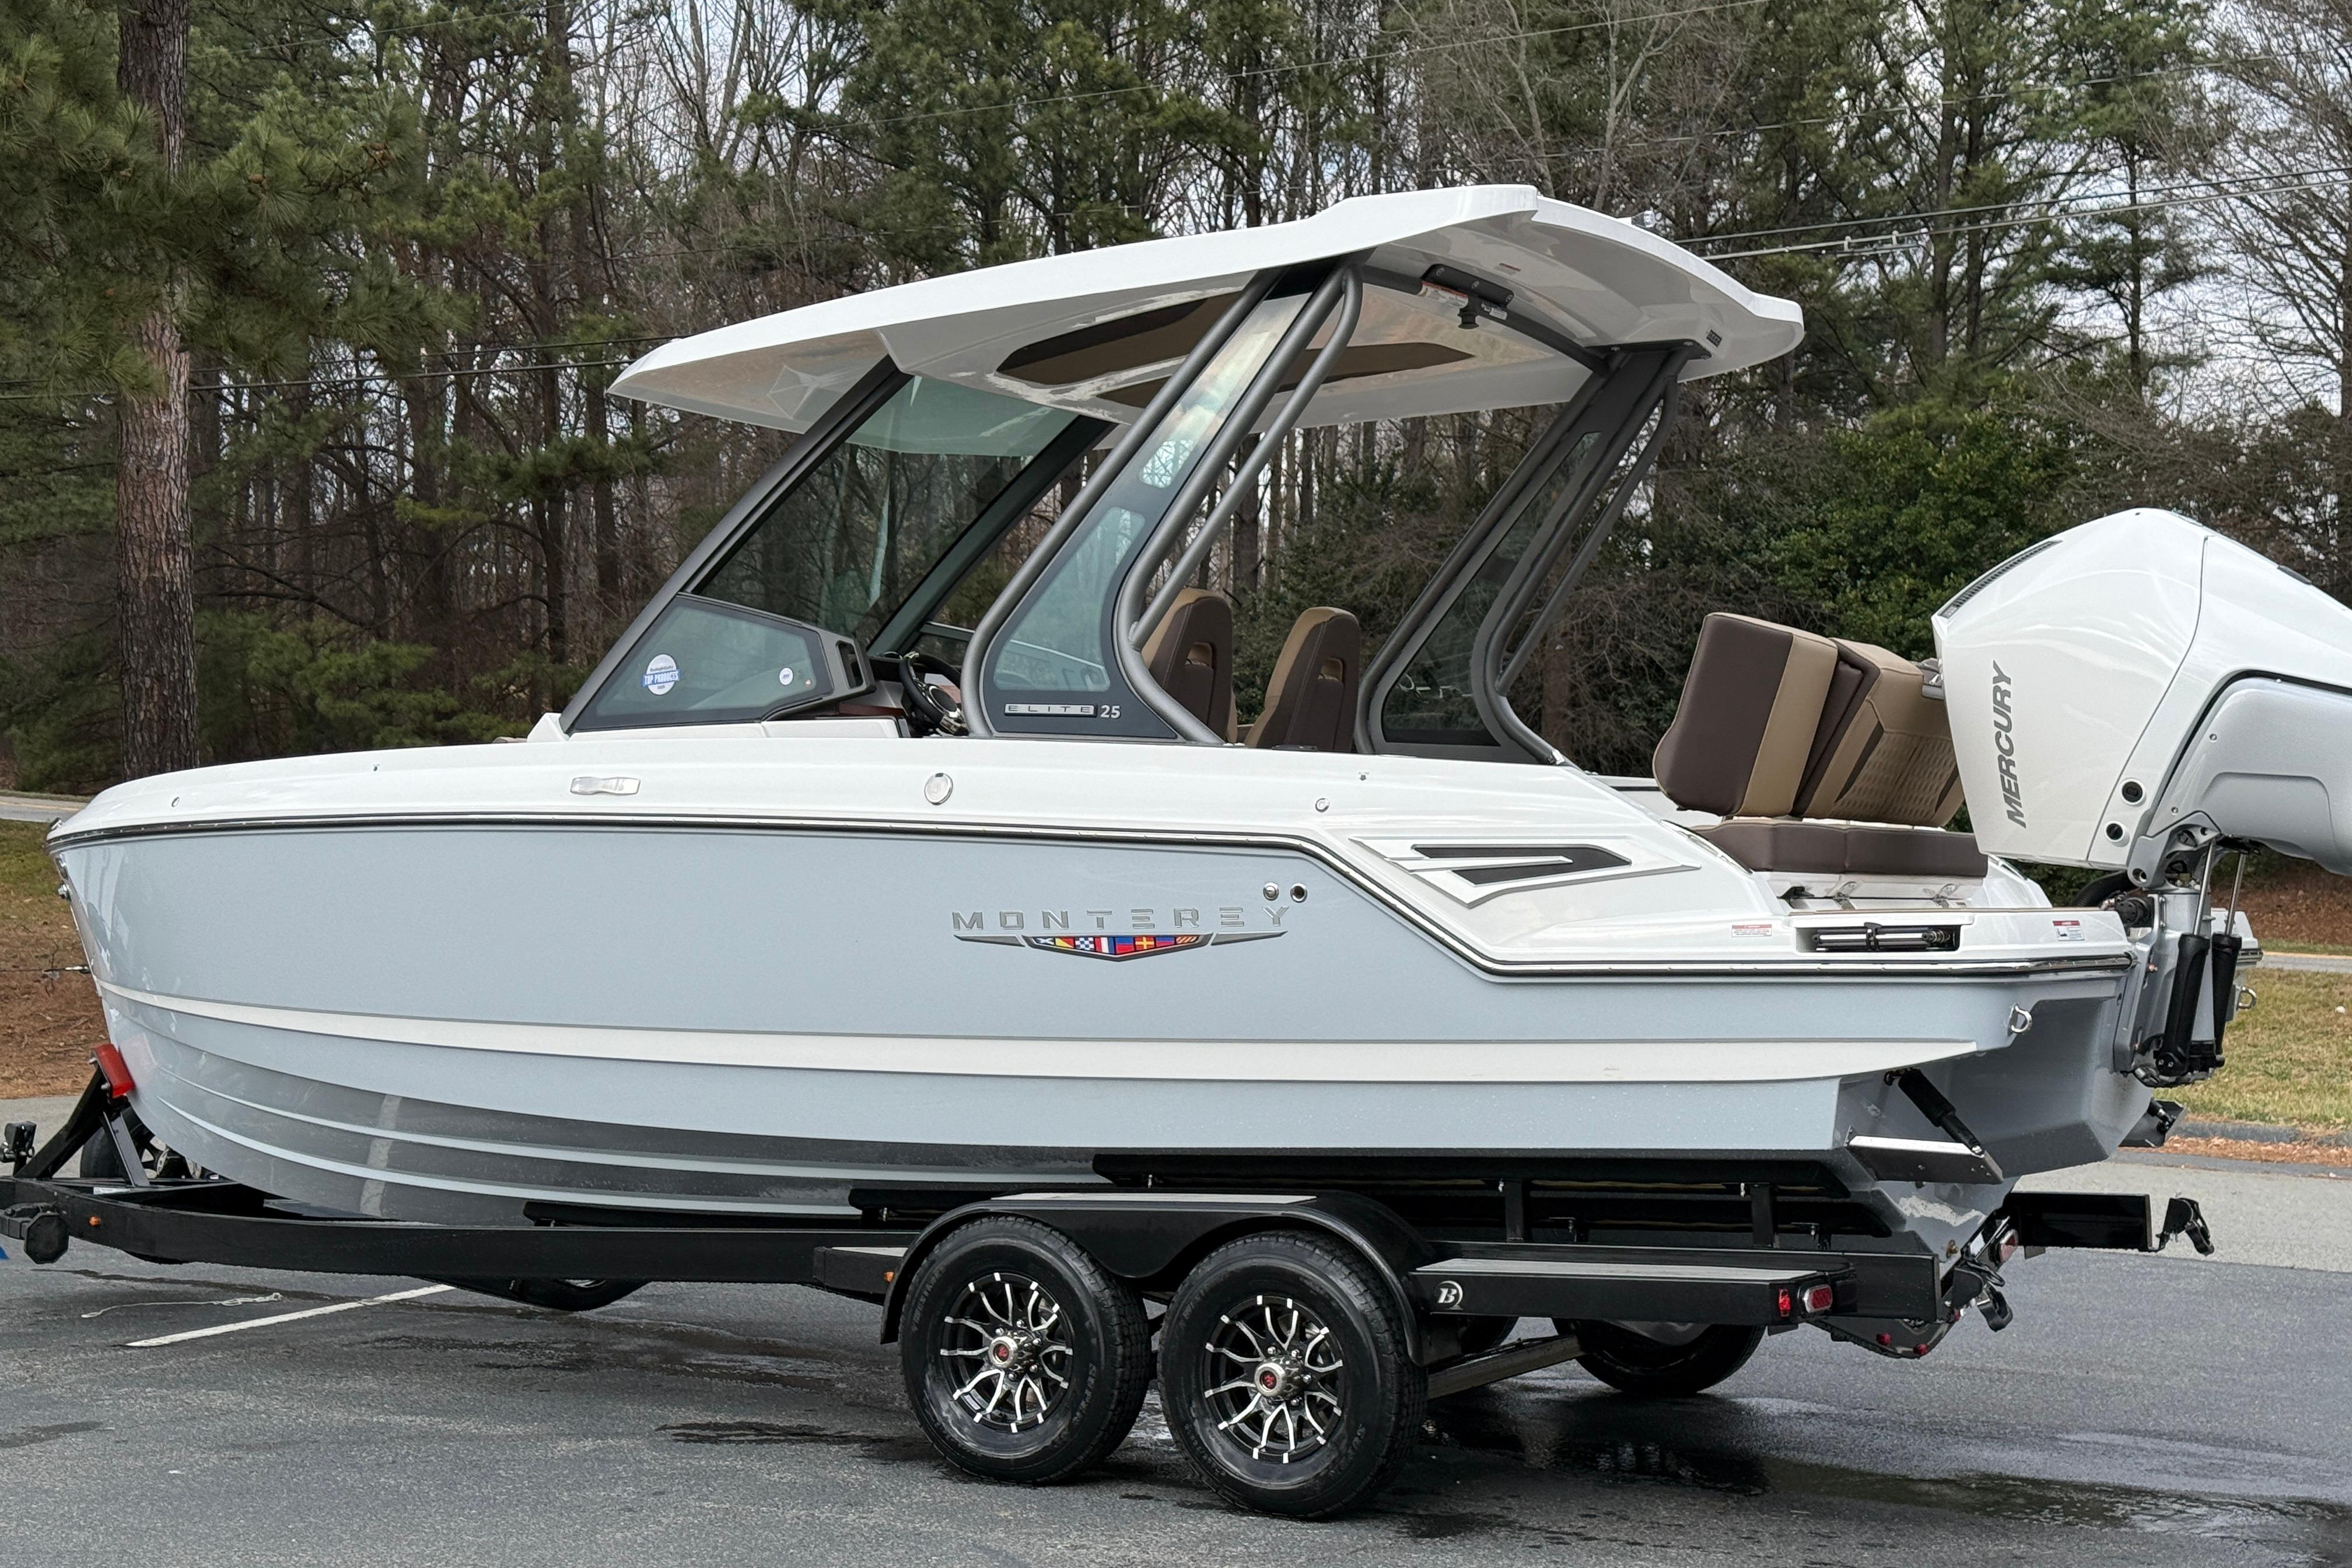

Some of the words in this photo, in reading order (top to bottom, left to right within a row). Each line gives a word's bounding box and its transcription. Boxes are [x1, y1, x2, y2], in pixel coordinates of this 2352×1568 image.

[644, 674, 653, 685] TOP
[1100, 705, 1121, 719] 25
[1993, 660, 2027, 829] MERCURY
[951, 906, 1289, 930] MONTEREY
